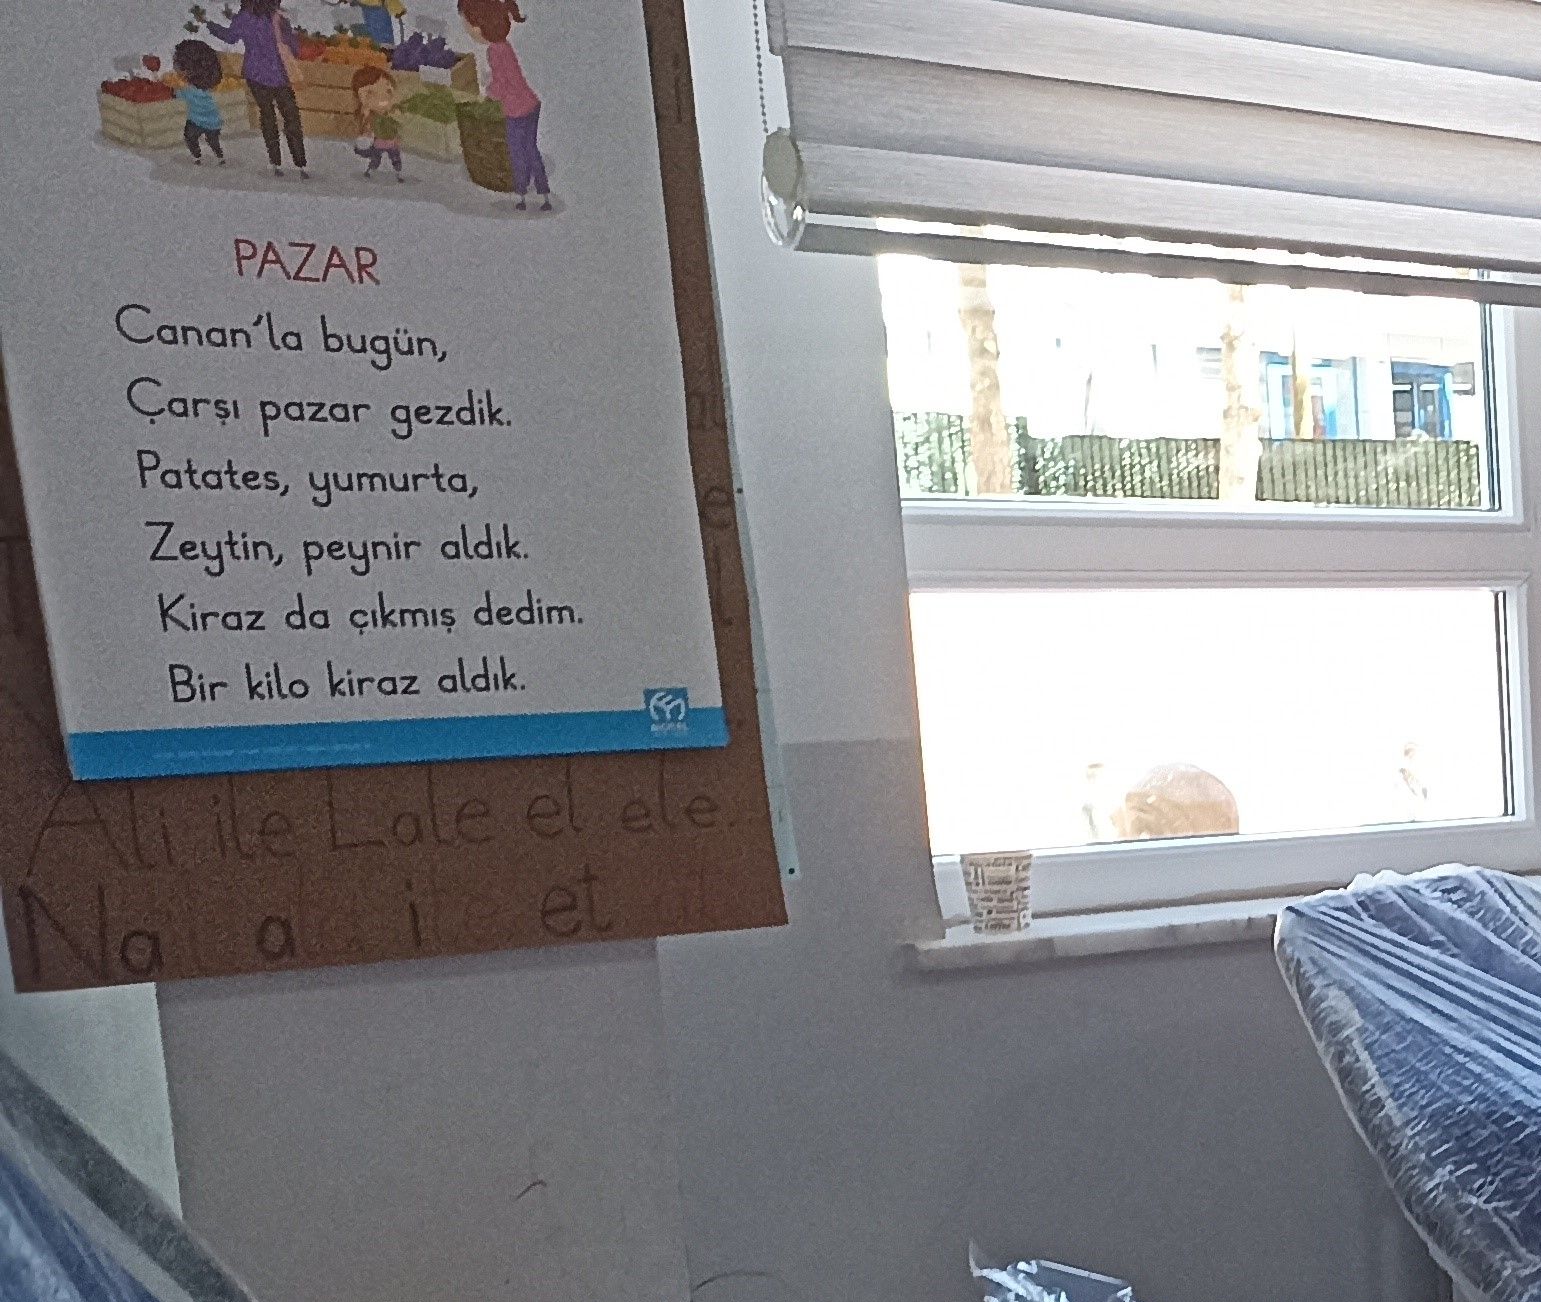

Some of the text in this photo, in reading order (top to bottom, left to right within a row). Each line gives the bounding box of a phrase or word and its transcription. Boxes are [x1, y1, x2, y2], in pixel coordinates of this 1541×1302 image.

[233, 237, 381, 286] PAZAR
[319, 314, 448, 372] bugün,
[126, 376, 512, 441] Çarşı pazar gezdik.
[136, 449, 479, 508] Patates, yumurta,
[144, 520, 529, 578] Zeytin, peynir aldık.
[157, 588, 584, 636] Kiraz da çıkmış dedim.
[168, 655, 526, 703] Bir kilo kiraz aldık.
[212, 778, 296, 860] ile
[328, 768, 496, 852] Lale
[525, 756, 584, 840] el
